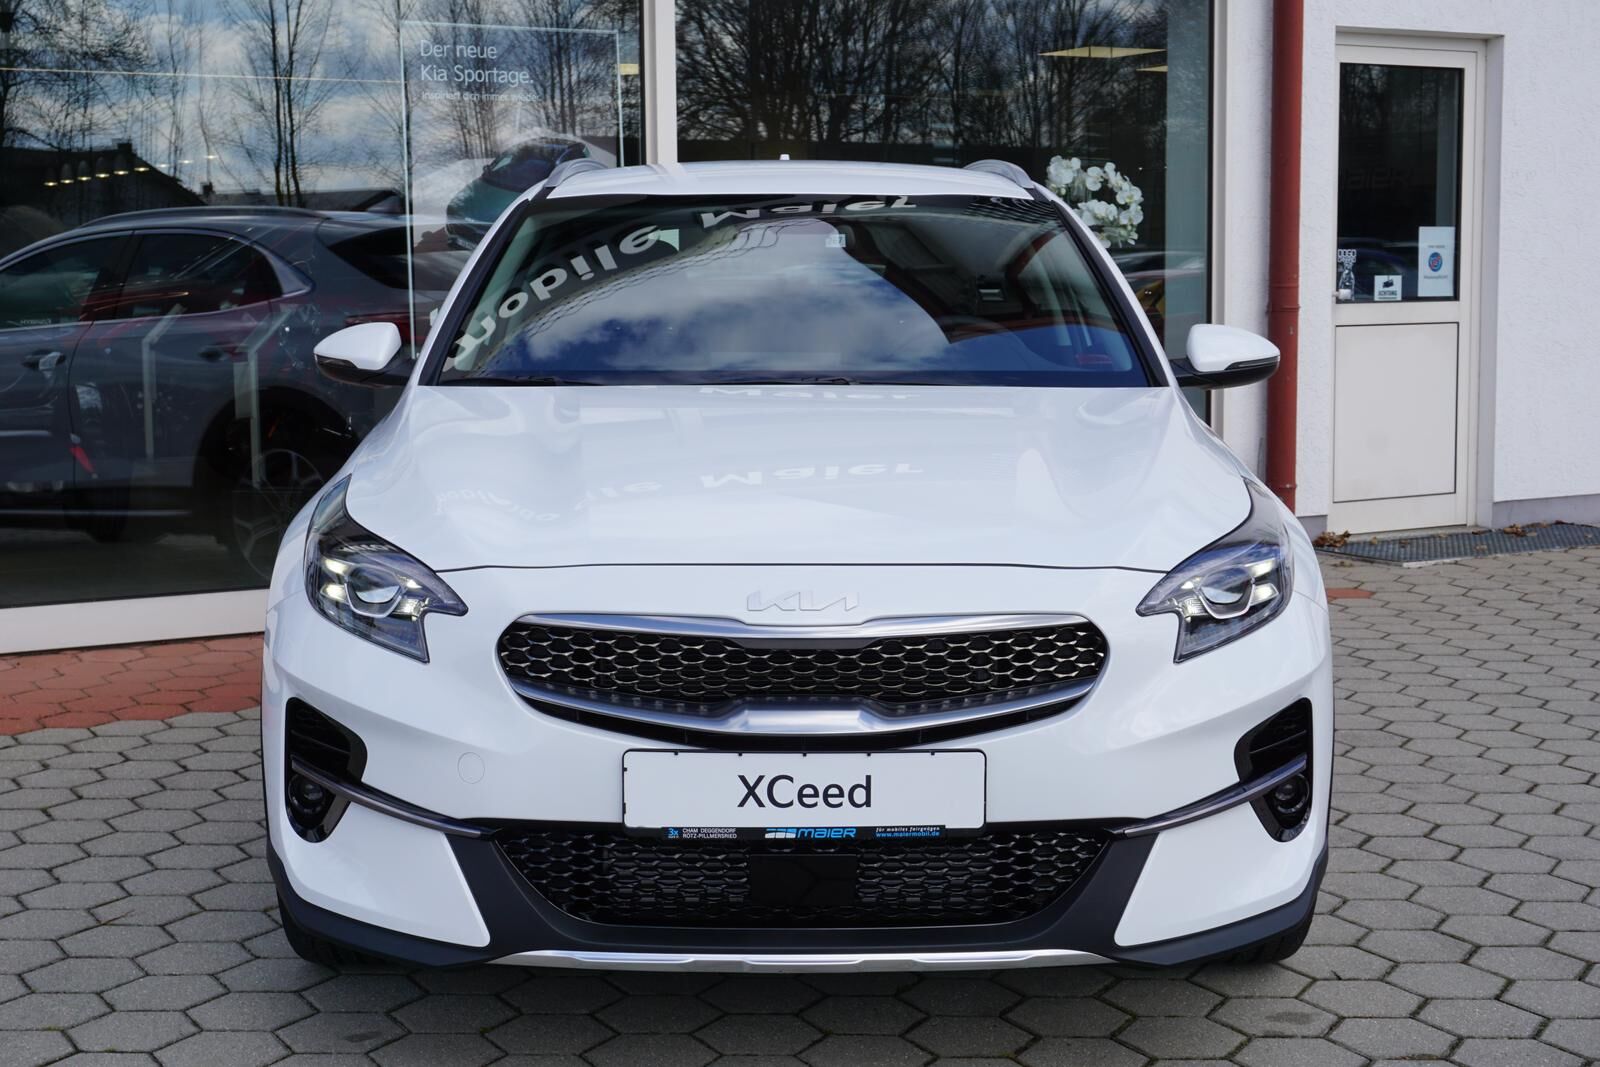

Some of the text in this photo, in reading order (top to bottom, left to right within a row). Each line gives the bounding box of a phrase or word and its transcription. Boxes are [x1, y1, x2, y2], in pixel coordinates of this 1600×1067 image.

[420, 40, 498, 59] Der neue
[421, 64, 534, 87] Kia Sportage.
[737, 774, 872, 809] XCeed
